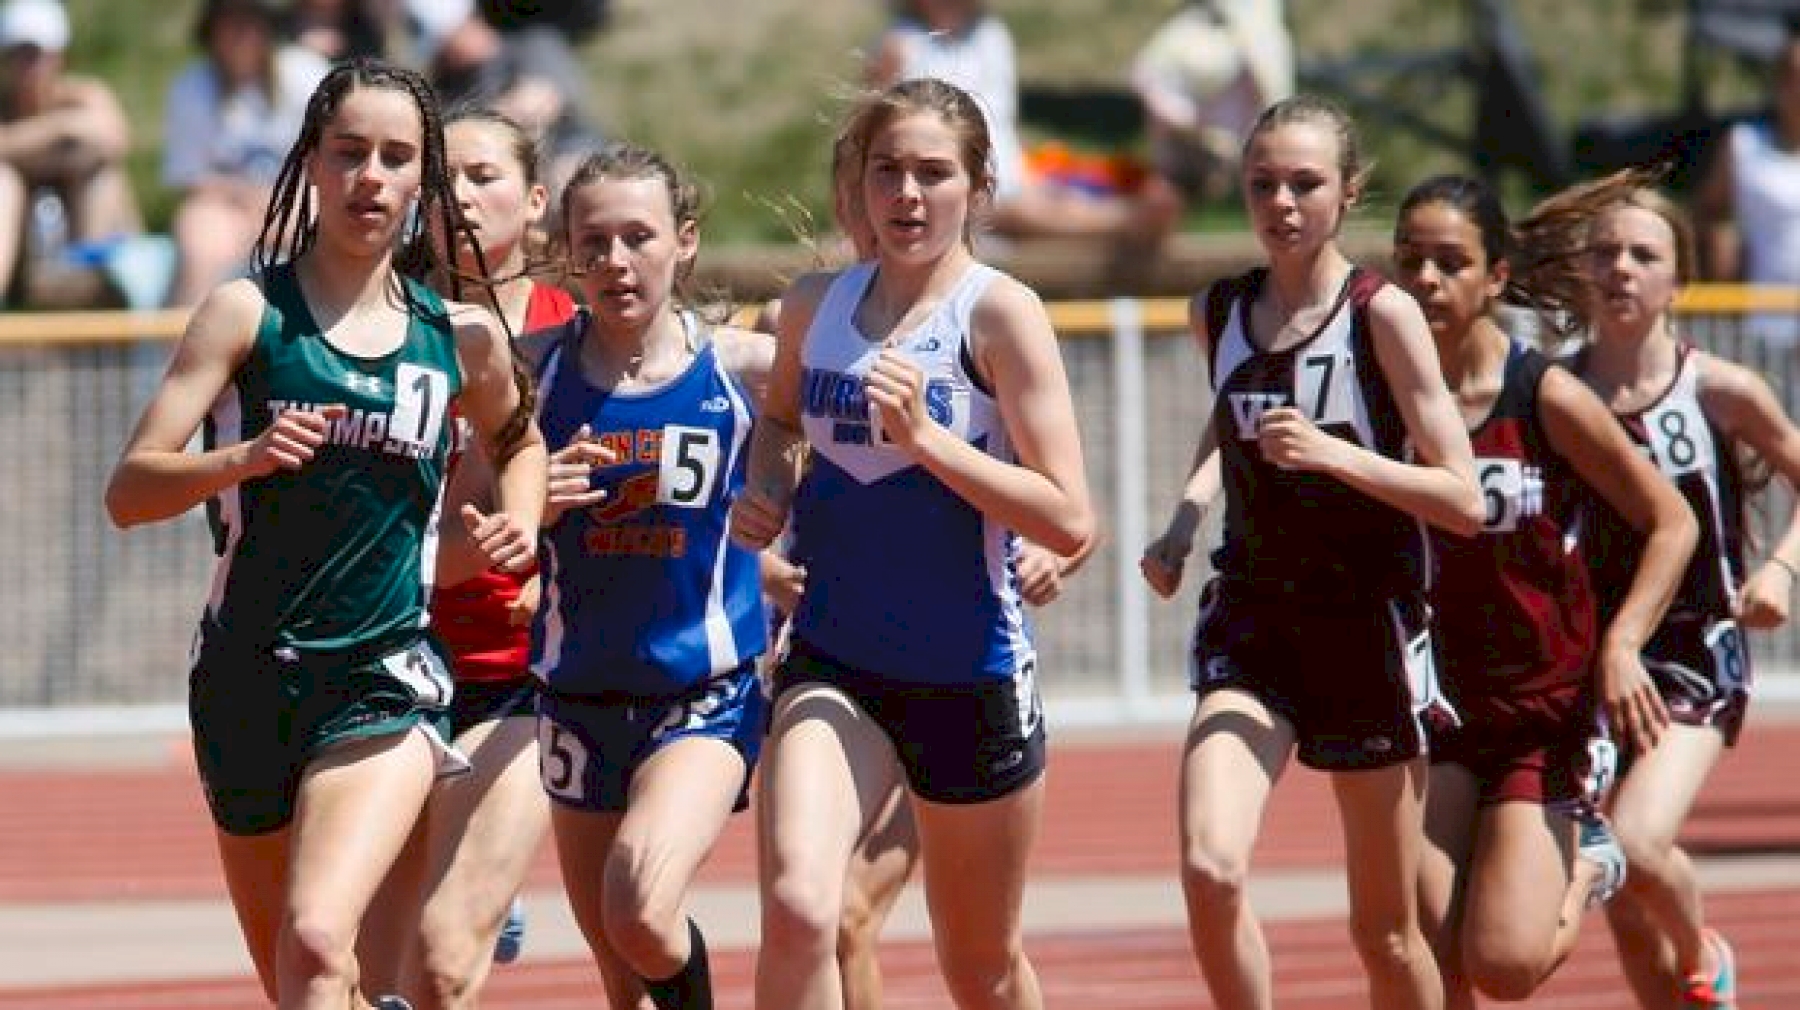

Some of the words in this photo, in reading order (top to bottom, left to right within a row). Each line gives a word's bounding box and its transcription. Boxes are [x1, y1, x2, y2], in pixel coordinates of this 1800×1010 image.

[411, 372, 433, 442] 1
[1305, 356, 1335, 420] 7
[672, 432, 710, 503] 5
[1658, 408, 1696, 468] 8
[1480, 463, 1506, 527] 6
